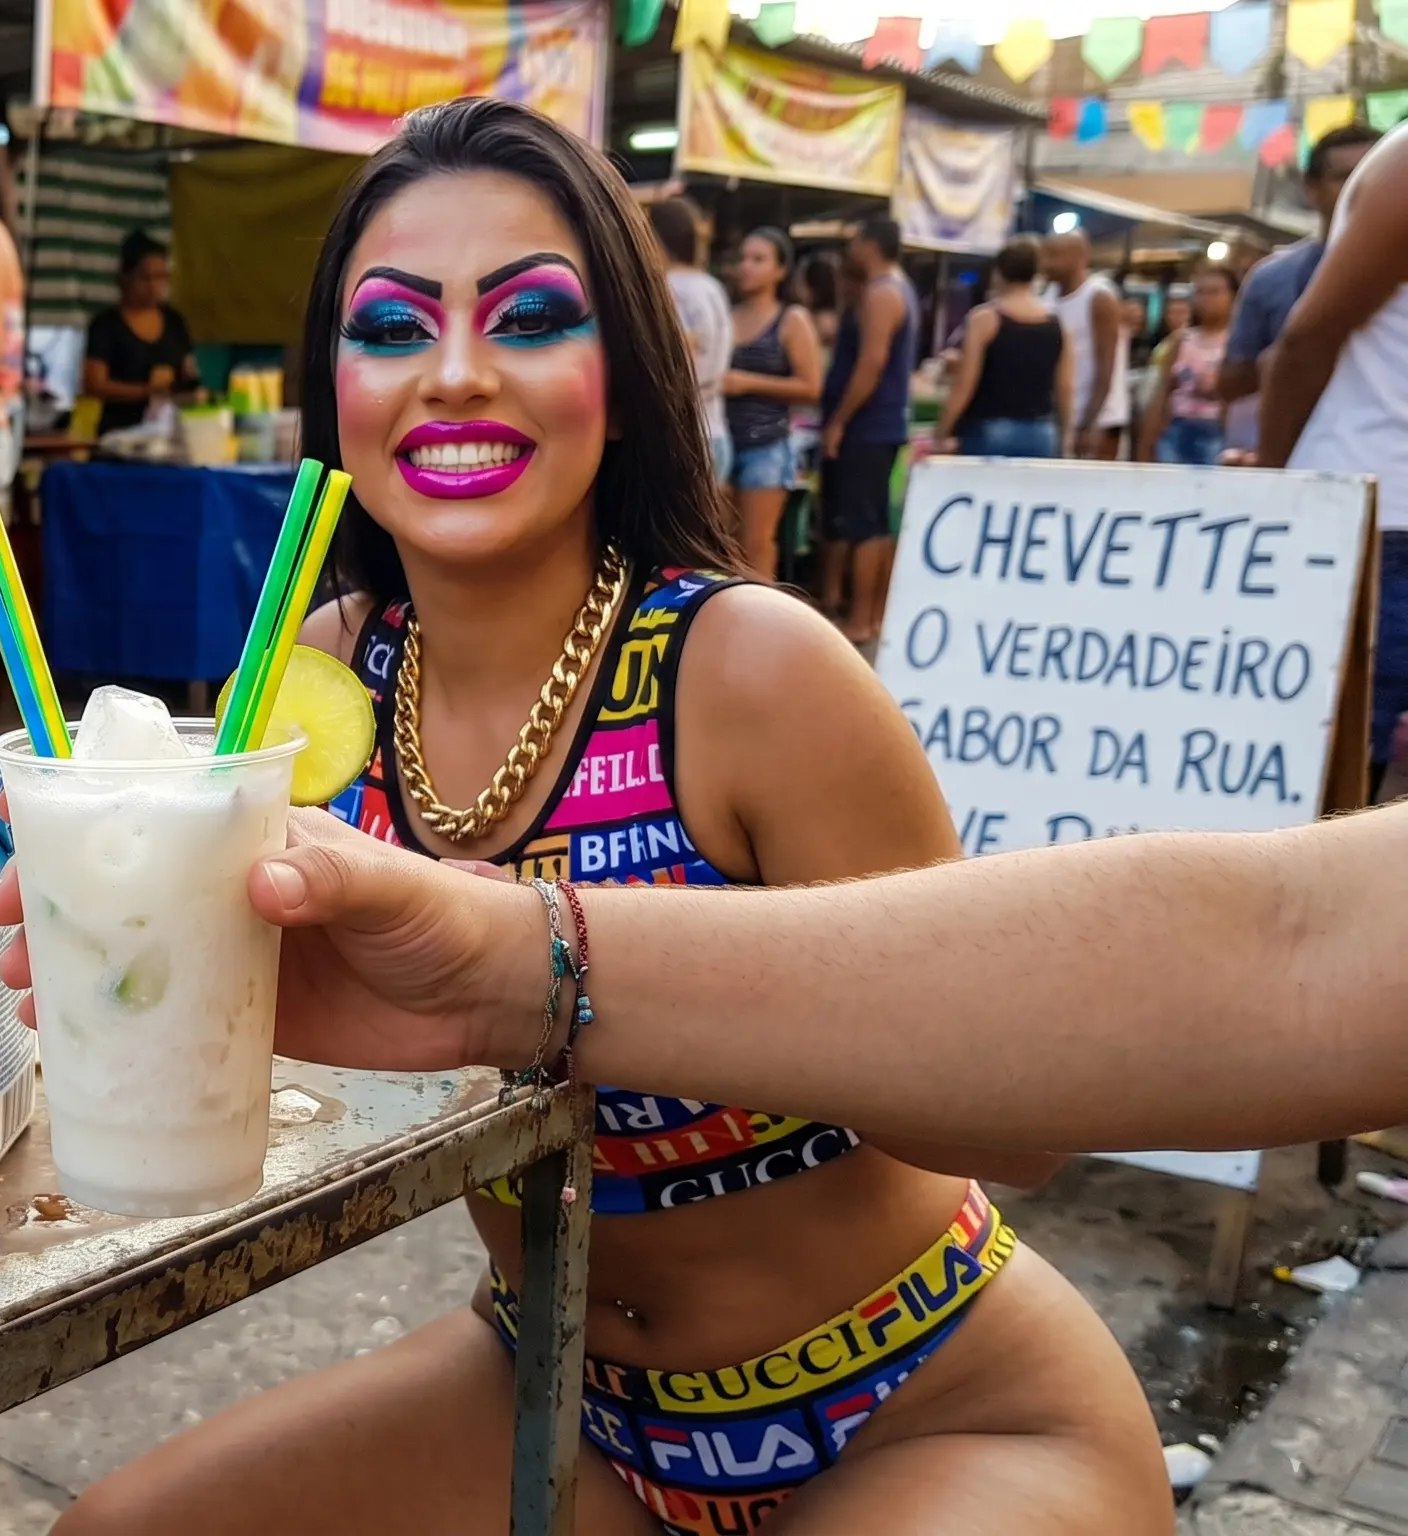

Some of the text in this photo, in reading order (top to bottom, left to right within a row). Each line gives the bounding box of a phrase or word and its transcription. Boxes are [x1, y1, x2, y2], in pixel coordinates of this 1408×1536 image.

[921, 492, 1292, 598] CHEVETTE
[905, 606, 950, 671] O
[1086, 728, 1149, 786] DA
[1176, 728, 1304, 804] RUA.
[658, 1318, 867, 1404] GUCCI
[858, 1244, 983, 1348] FILA
[643, 1423, 816, 1478] FILA
